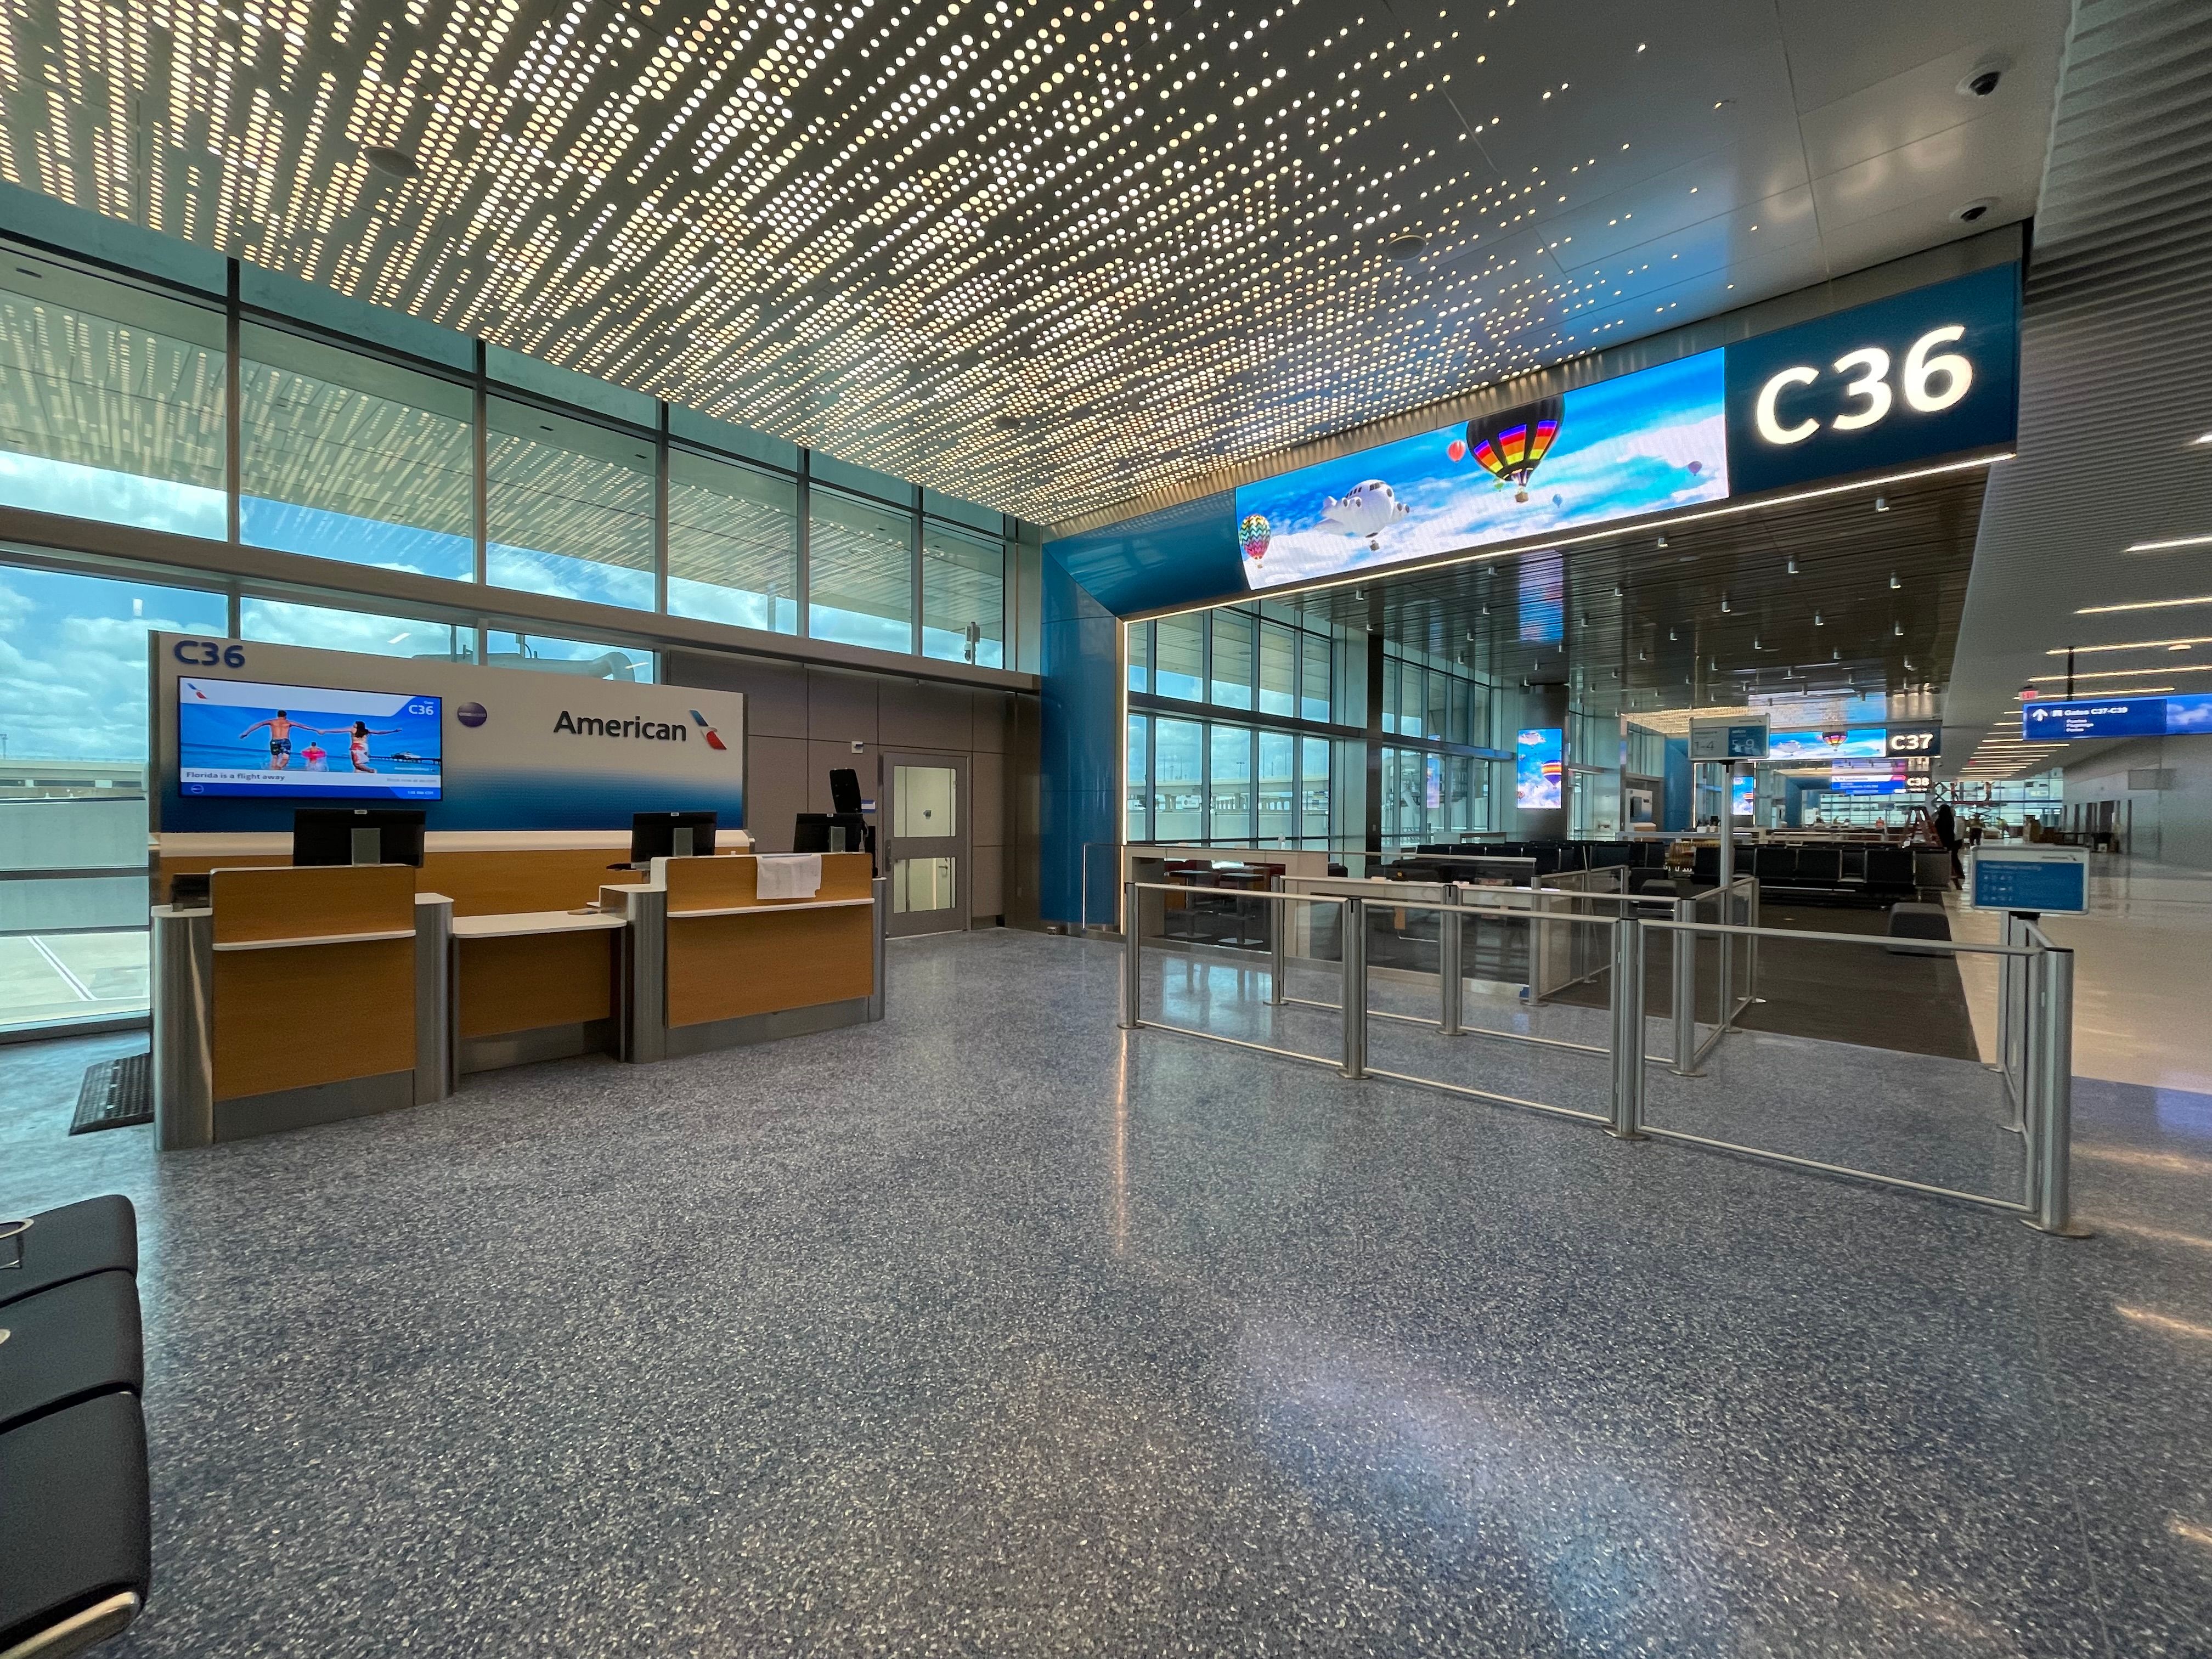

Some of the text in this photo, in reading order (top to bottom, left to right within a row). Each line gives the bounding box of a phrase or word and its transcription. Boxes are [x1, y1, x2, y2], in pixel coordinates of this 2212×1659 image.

[1756, 325, 1973, 444] C36
[173, 640, 246, 668] C36
[408, 704, 434, 715] C36
[553, 710, 686, 742] American
[1891, 732, 1934, 750] C37
[1906, 777, 1930, 786] C38
